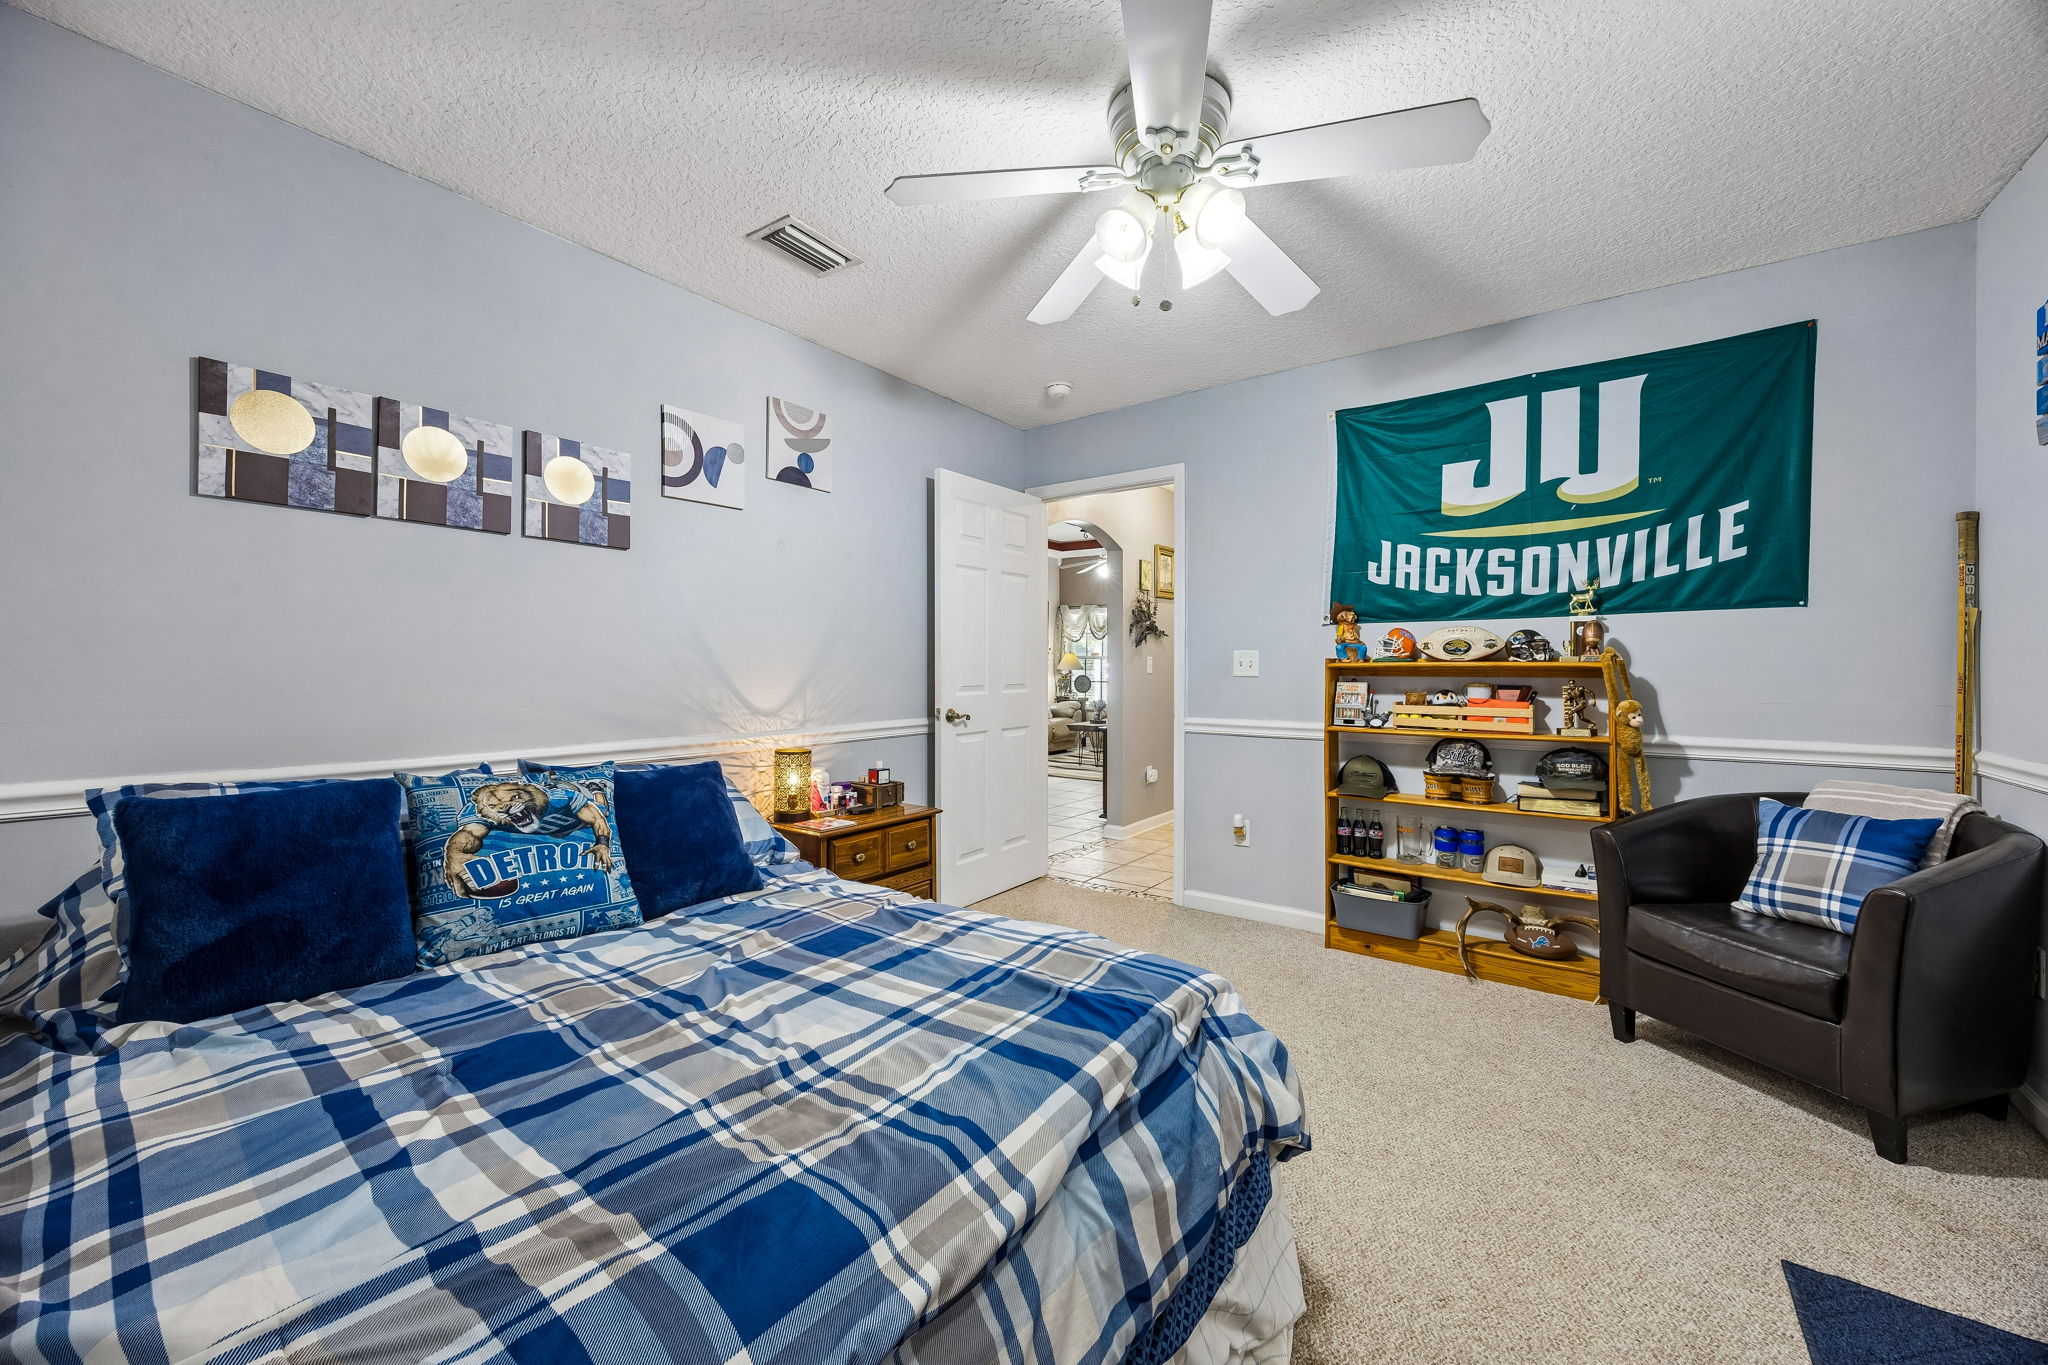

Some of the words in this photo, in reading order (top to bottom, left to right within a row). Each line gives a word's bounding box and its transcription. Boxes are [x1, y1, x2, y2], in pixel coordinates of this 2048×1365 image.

[1441, 374, 1649, 516] JU
[1367, 500, 1750, 597] JACKSONVILLE
[499, 898, 511, 909] IS
[516, 889, 558, 905] GREAT
[560, 883, 594, 897] AGAIN
[485, 943, 499, 954] MY
[501, 935, 528, 950] HEART
[529, 928, 564, 942] BELONGS
[567, 925, 576, 935] TO
